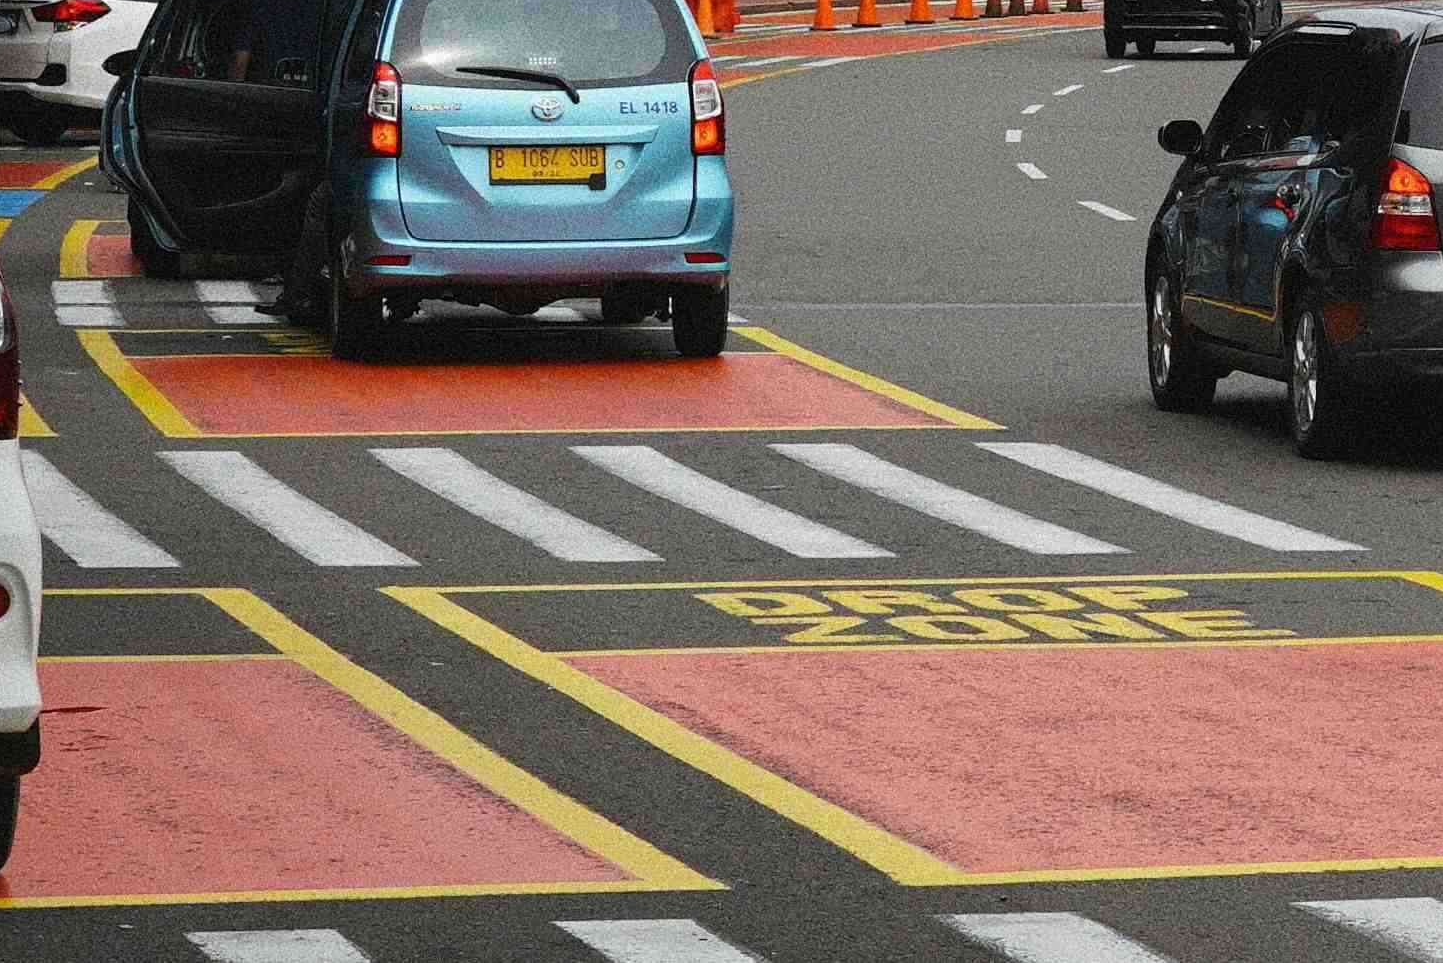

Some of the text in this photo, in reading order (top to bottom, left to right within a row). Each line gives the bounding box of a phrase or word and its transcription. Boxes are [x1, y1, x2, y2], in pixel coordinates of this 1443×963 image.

[619, 100, 679, 114] EL 1418
[495, 148, 505, 168] B
[569, 147, 599, 168] SUB
[694, 583, 1192, 620] DROP
[750, 607, 1300, 644] ZONE
